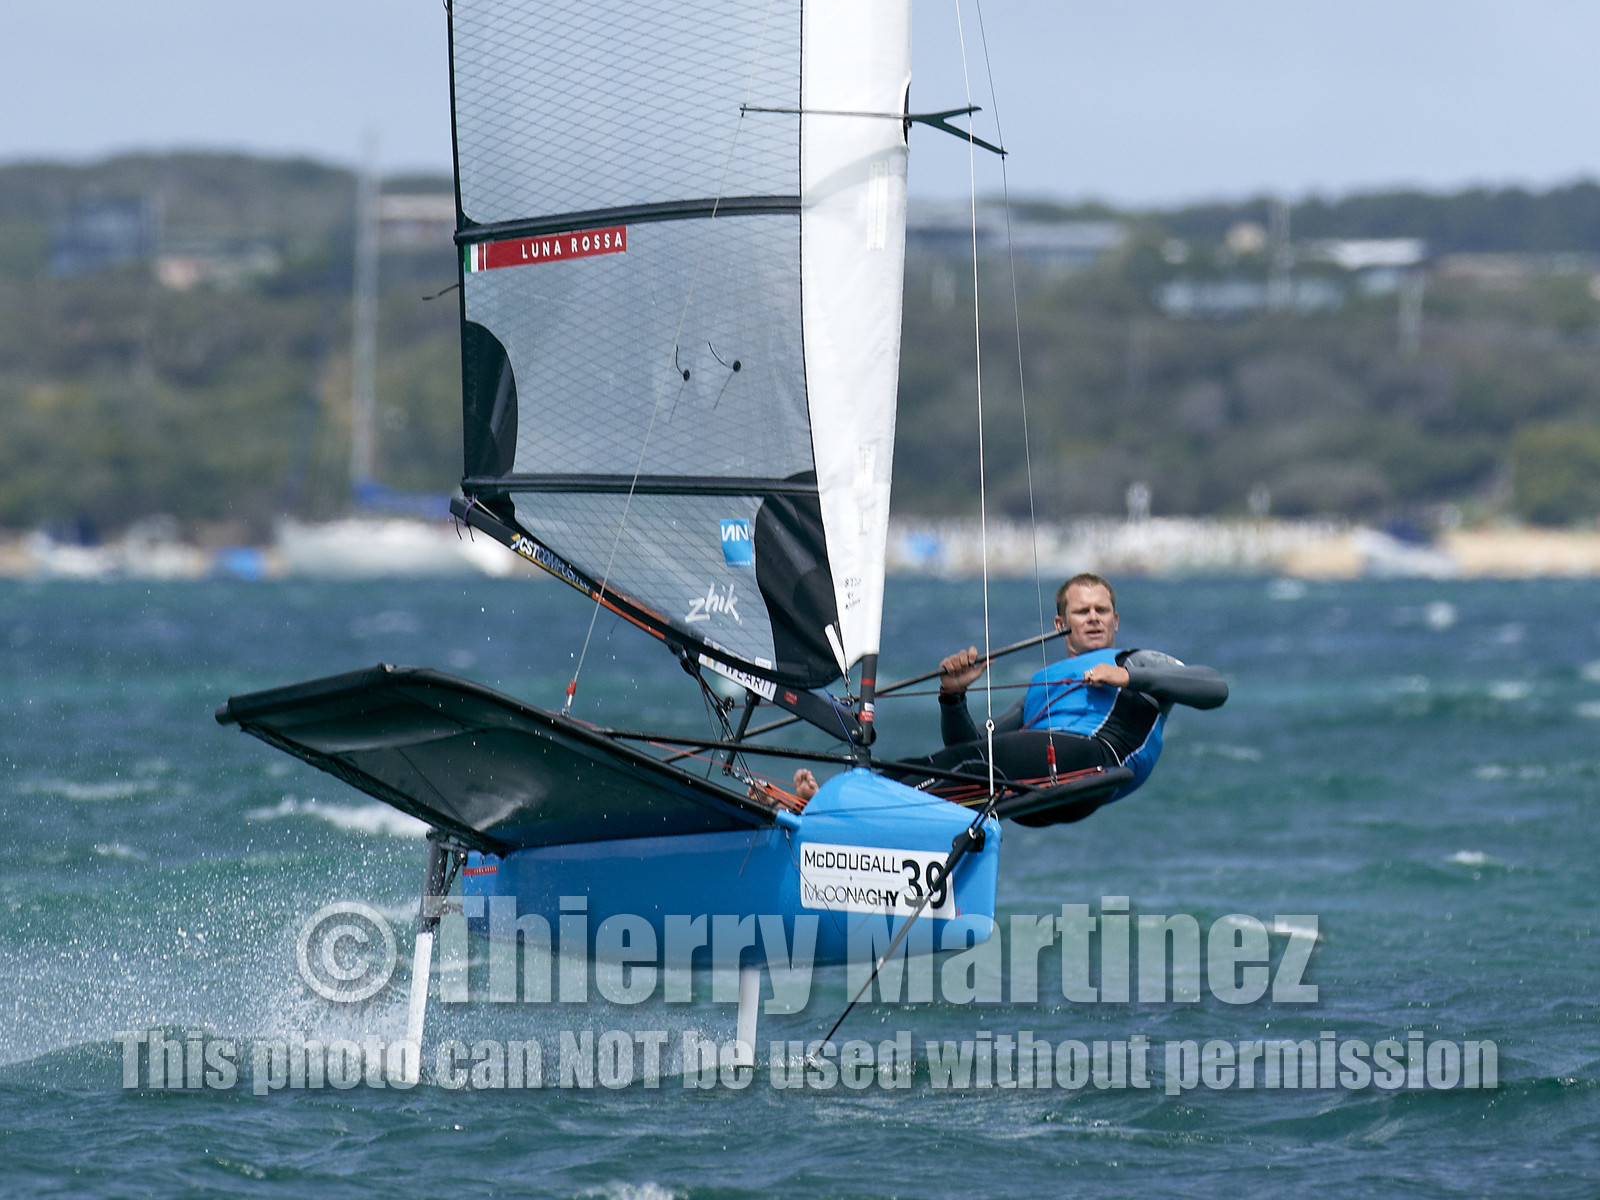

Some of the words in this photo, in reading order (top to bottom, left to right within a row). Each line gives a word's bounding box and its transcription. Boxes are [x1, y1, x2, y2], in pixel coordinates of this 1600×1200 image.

[521, 240, 561, 259] LUNA
[571, 231, 623, 253] ROSSA
[804, 850, 901, 874] McDOUGALL
[804, 883, 899, 908] McCONAGHY
[901, 859, 948, 909] 39
